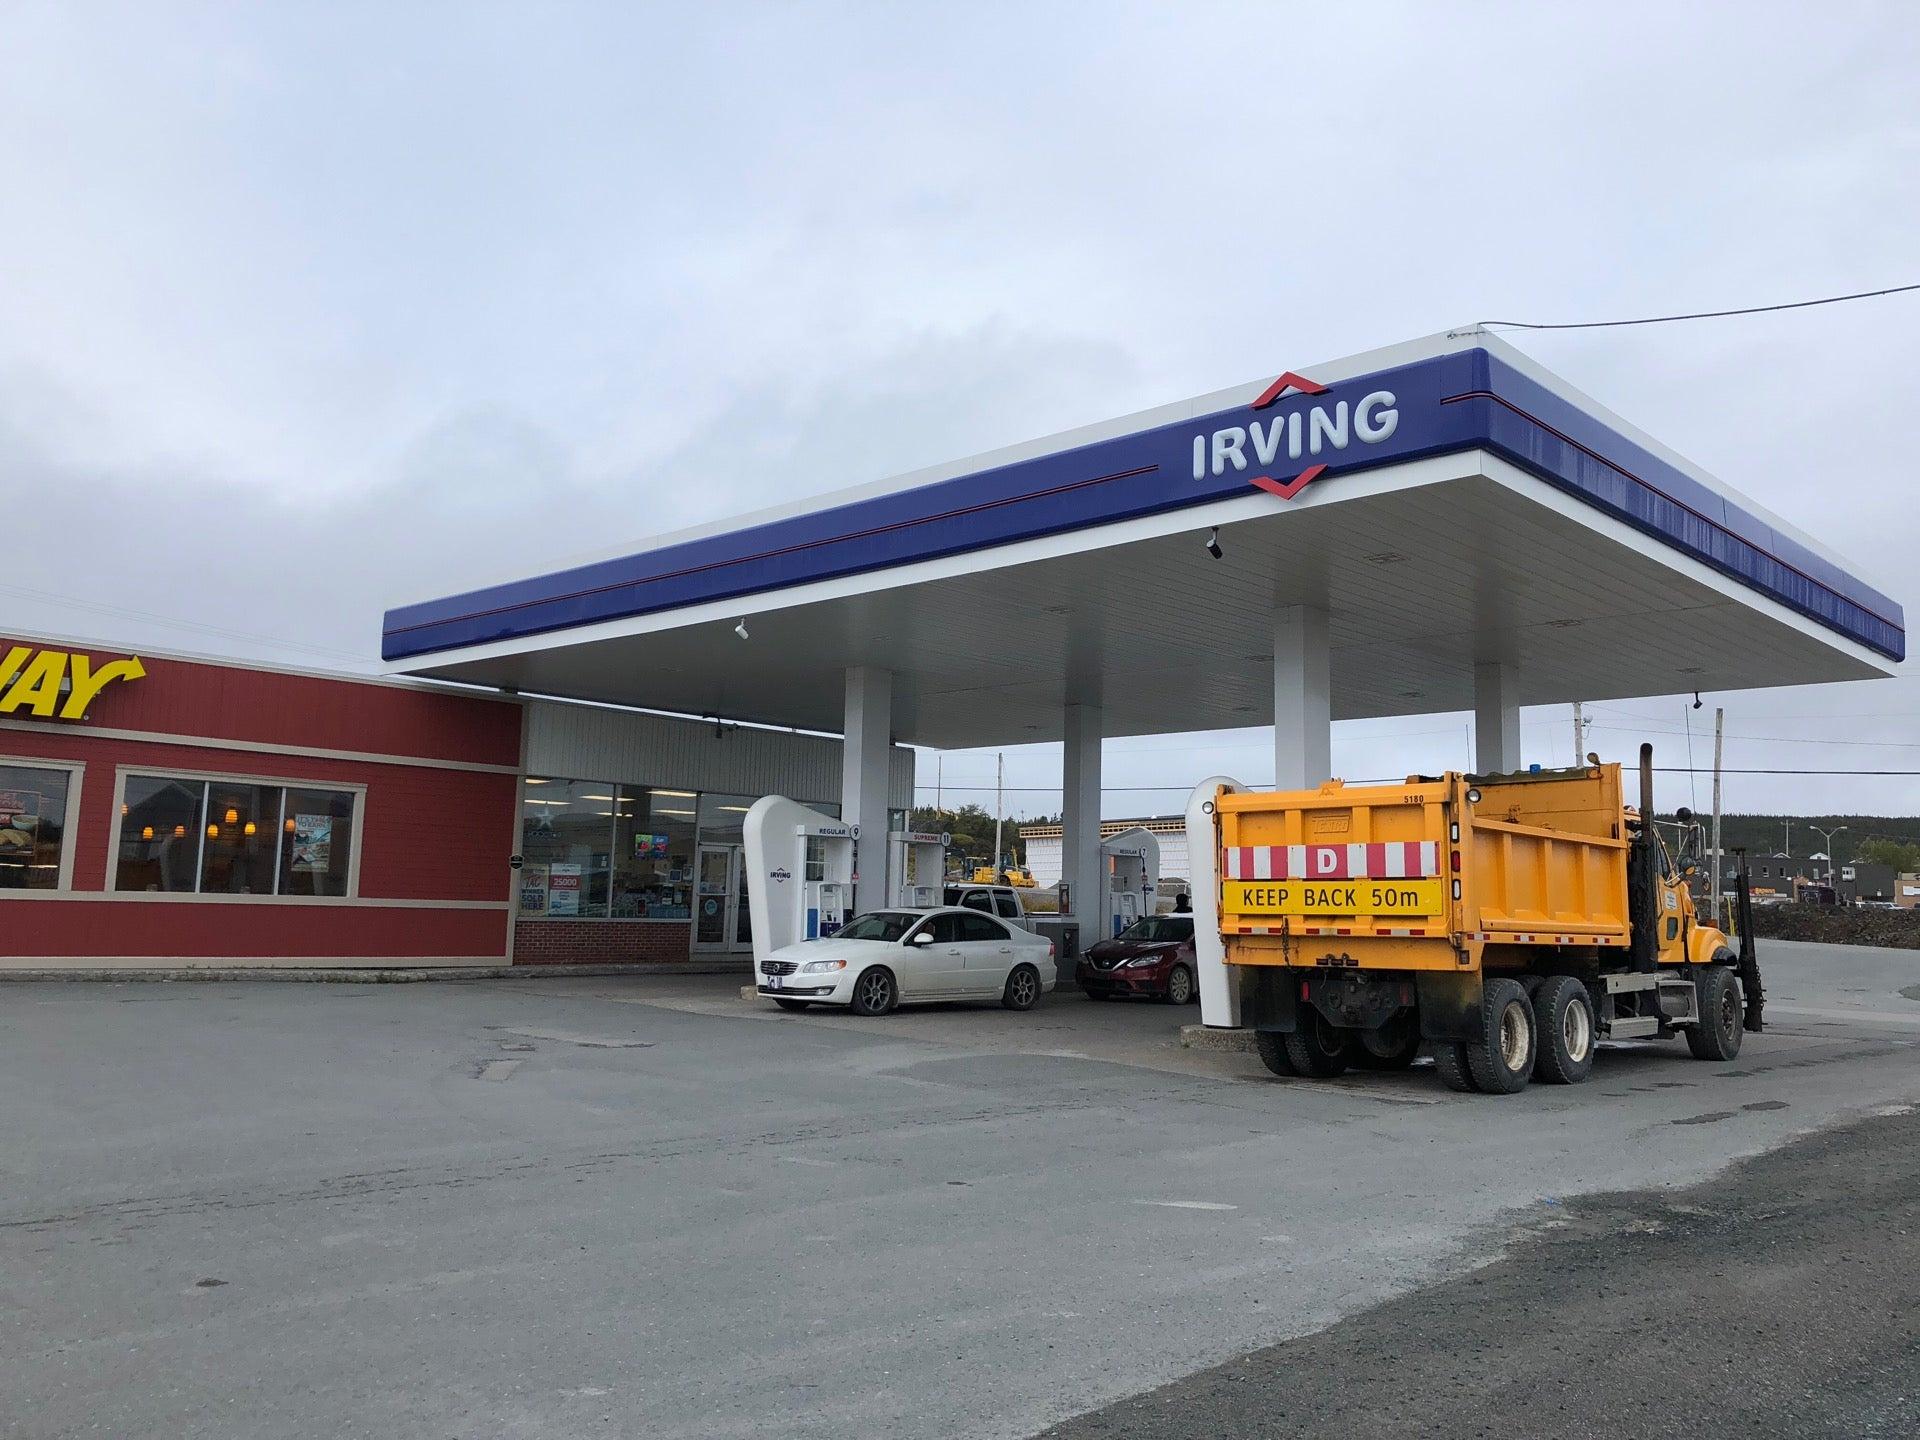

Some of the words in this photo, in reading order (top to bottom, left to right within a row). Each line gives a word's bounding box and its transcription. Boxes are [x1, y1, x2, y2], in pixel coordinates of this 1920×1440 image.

[1193, 390, 1399, 481] IRVING
[1404, 795, 1424, 803] 5180
[853, 828, 859, 836] 9
[943, 835, 949, 843] 11
[1317, 848, 1338, 874] D
[770, 871, 791, 879] IRVING
[553, 878, 577, 886] 25000
[1243, 888, 1289, 906] KEEP
[1304, 888, 1356, 906] BACK
[1372, 888, 1418, 906] 50m
